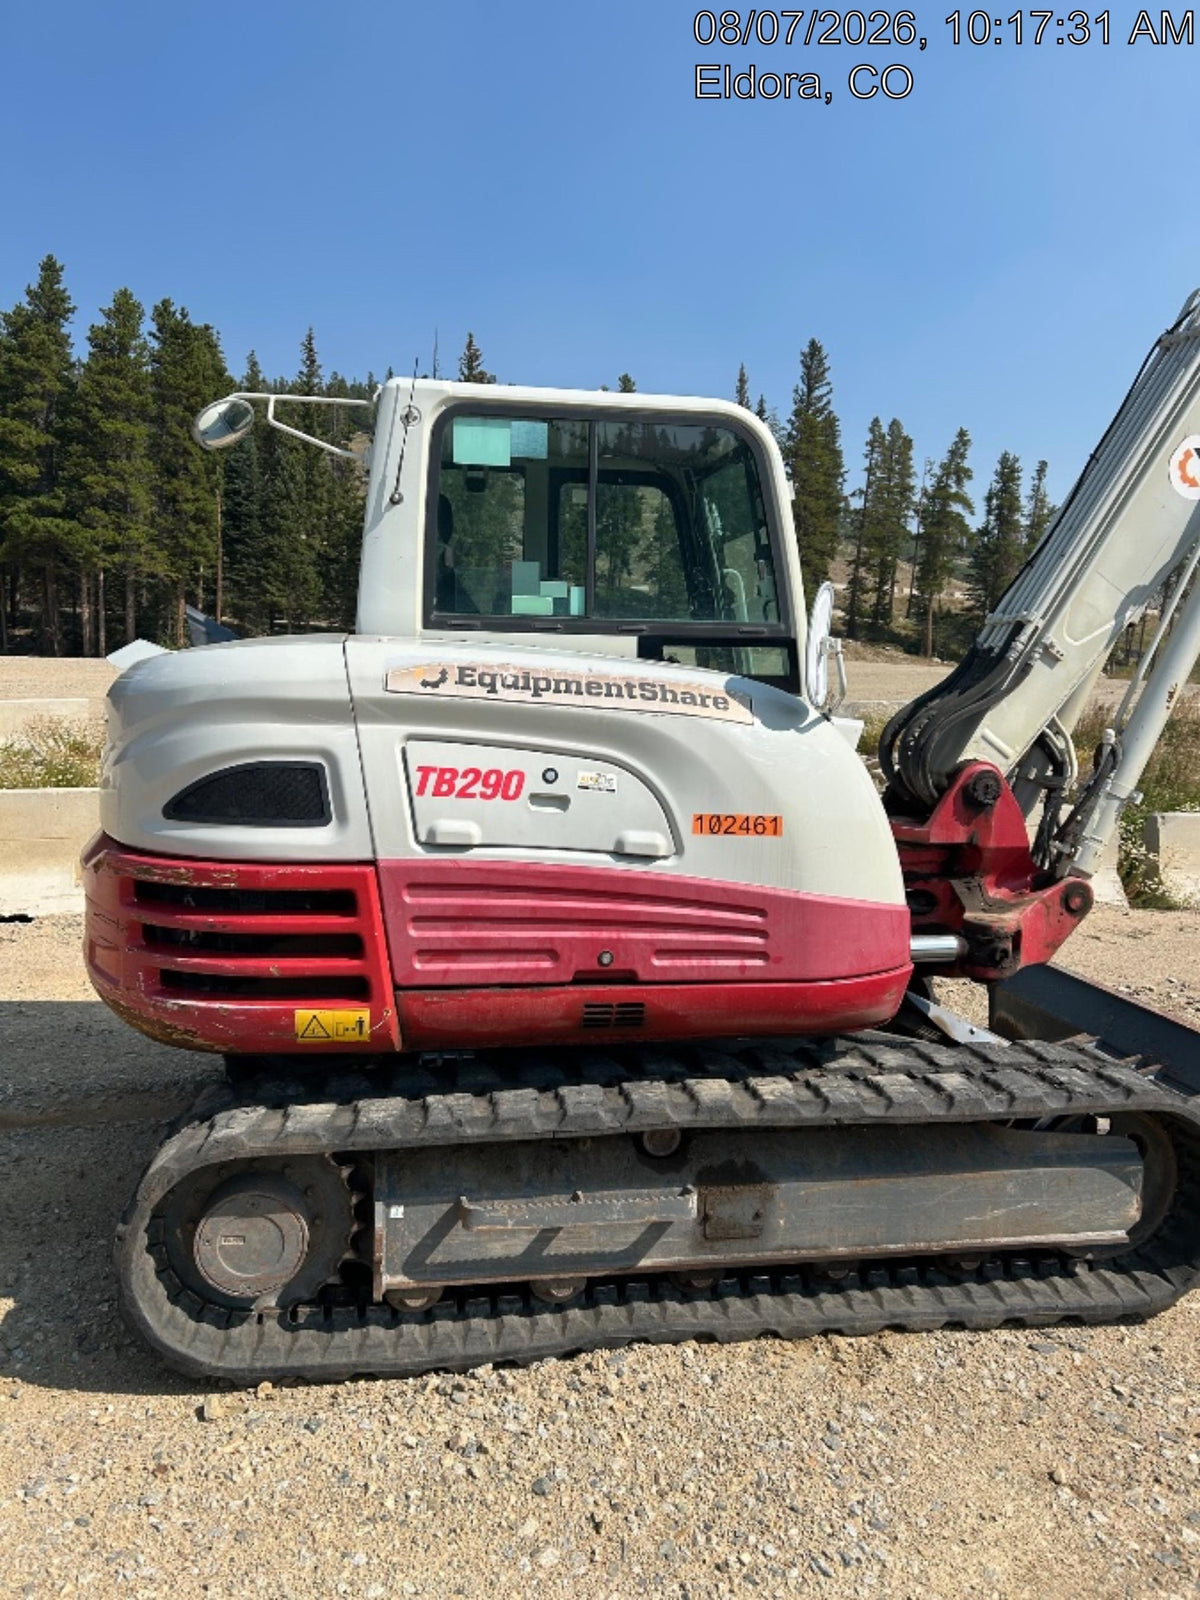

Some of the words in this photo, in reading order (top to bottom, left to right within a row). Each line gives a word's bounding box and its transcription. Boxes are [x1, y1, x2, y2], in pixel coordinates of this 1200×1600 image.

[455, 666, 730, 711] EquipmentShare
[415, 766, 526, 801] TB290
[695, 814, 780, 835] 102461
